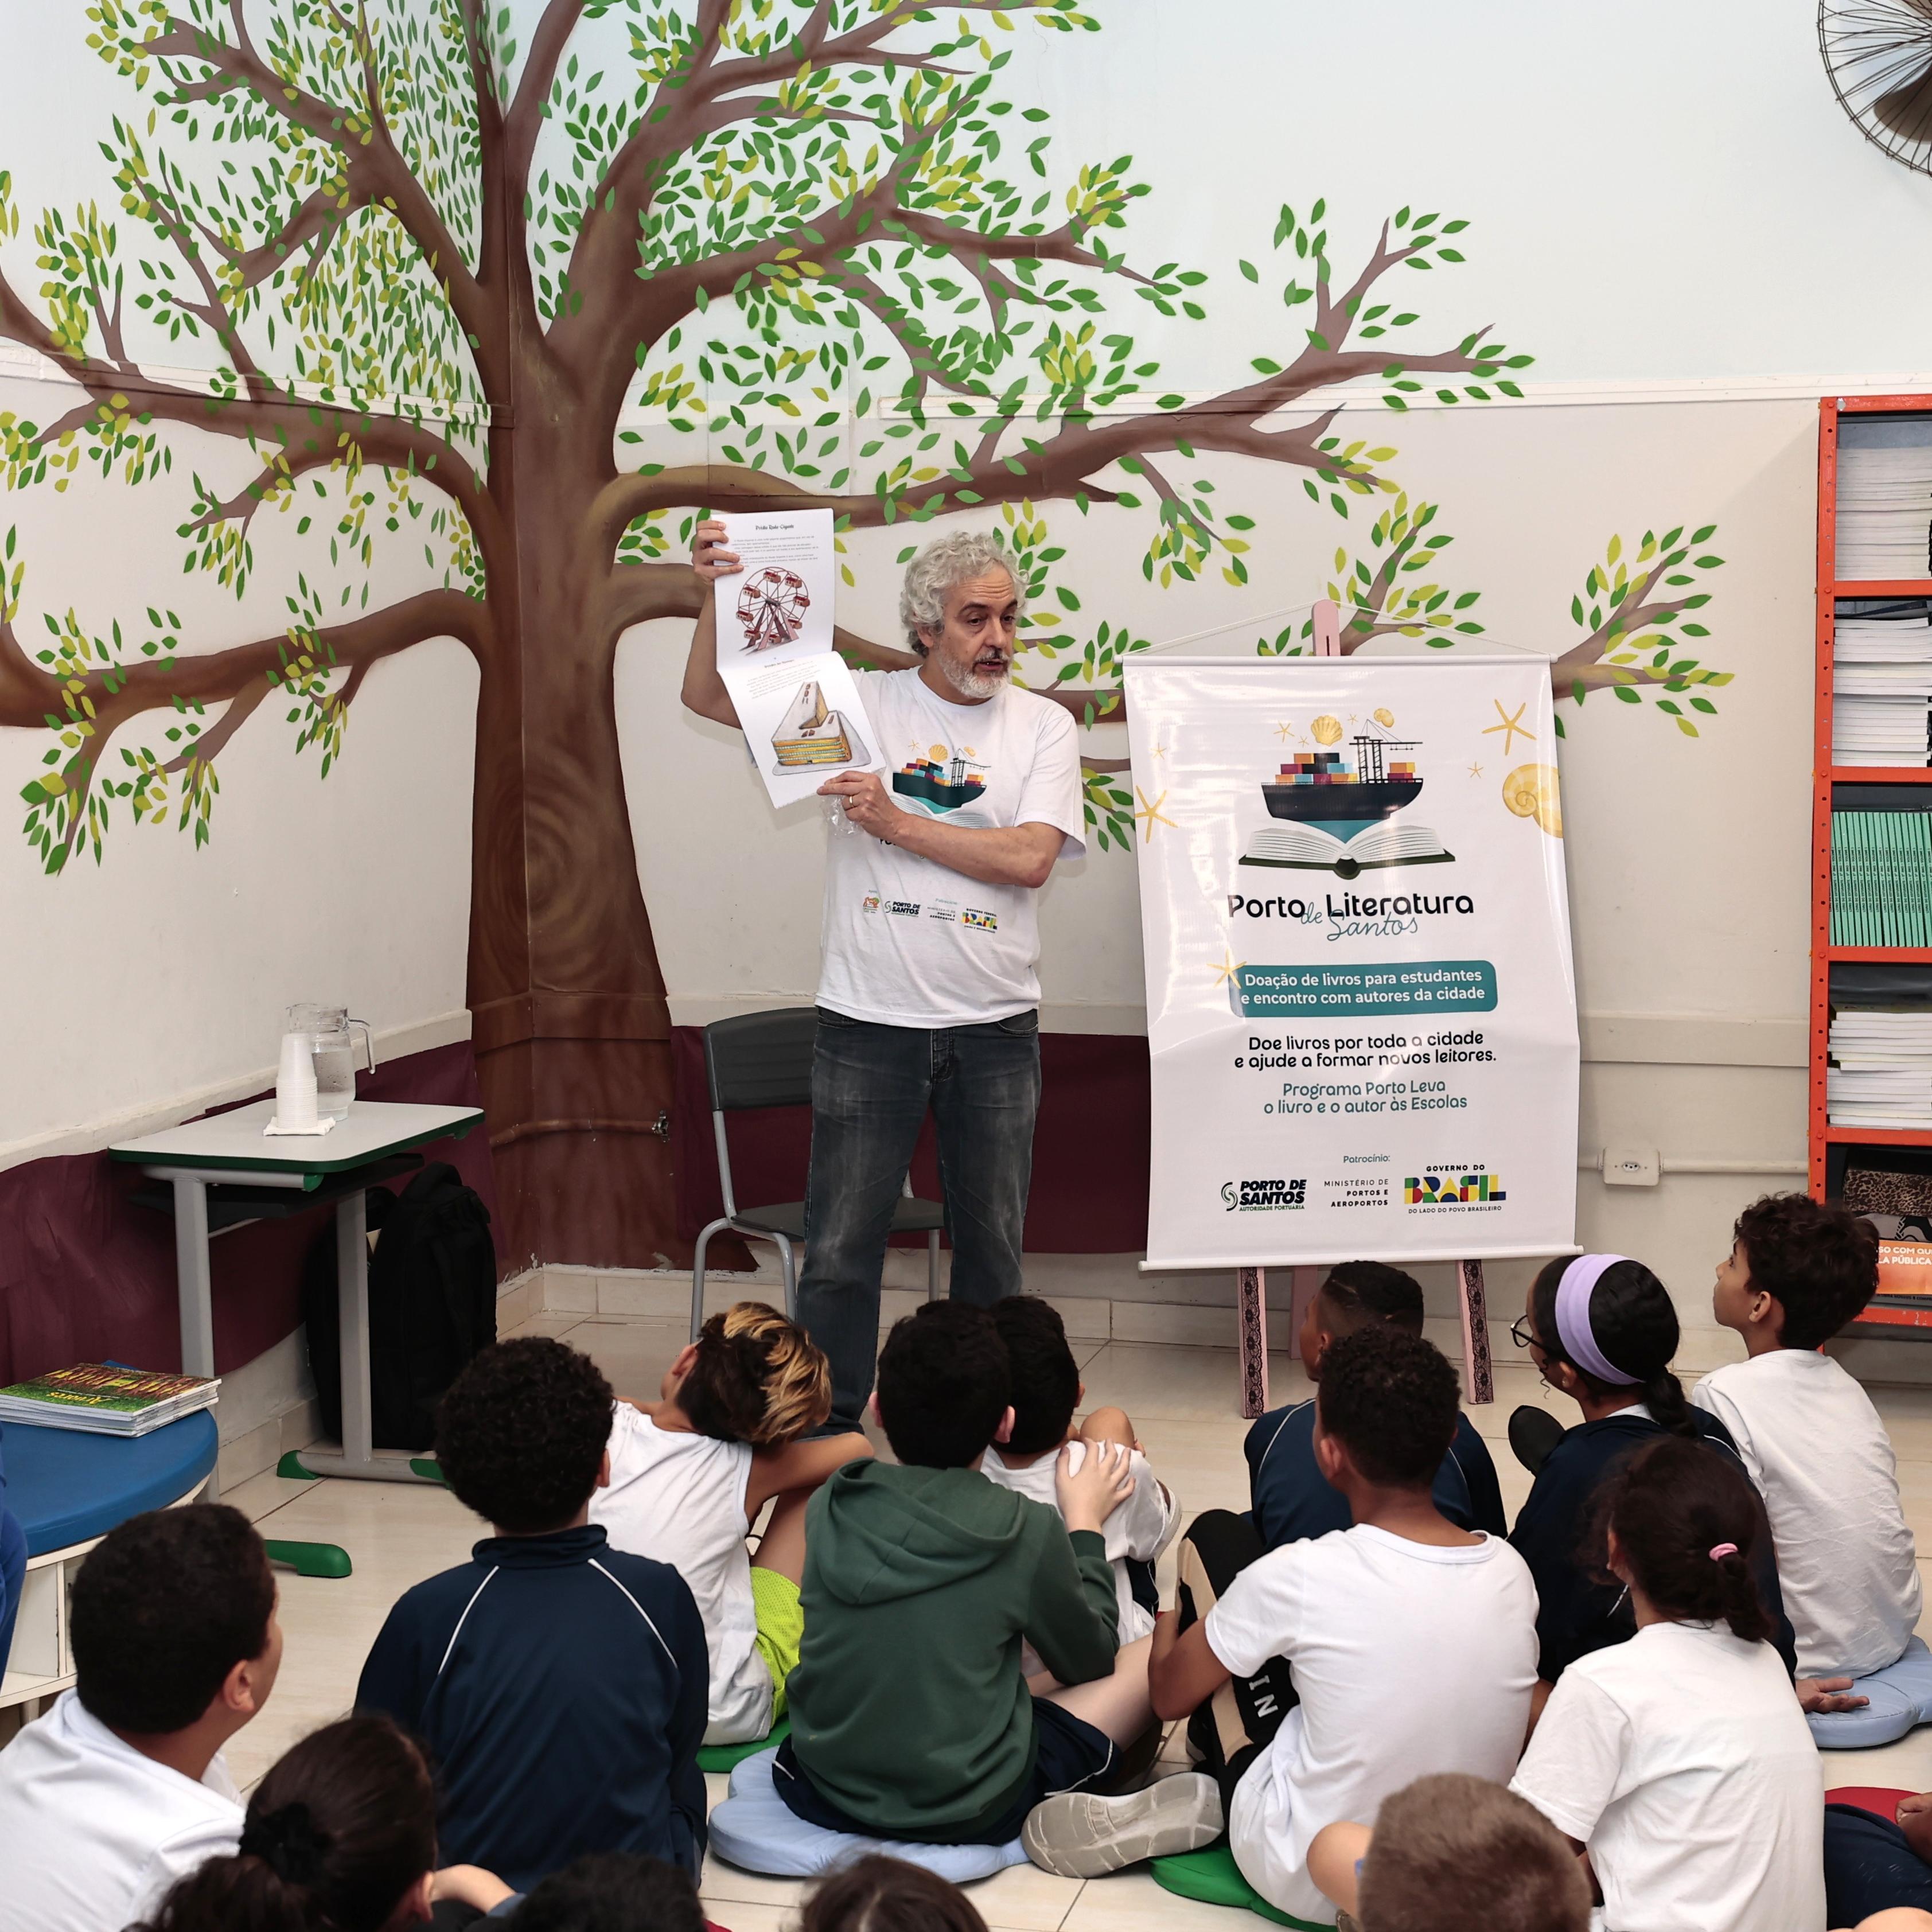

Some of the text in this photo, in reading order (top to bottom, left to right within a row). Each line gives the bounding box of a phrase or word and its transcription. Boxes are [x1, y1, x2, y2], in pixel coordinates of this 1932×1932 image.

[891, 906, 919, 915] SANTOS
[1228, 893, 1474, 925] Porto de Literatura
[961, 912, 998, 930] BRASIL
[1327, 909, 1418, 941] Santos
[1245, 969, 1482, 990] Doação de livros para estudantes
[1241, 987, 1485, 1004] e encontro com autores da cidade
[1249, 1031, 1483, 1053] Doe livros por toda a cidade
[1235, 1049, 1496, 1071] e ajude a formar novos leitores.
[1284, 1081, 1445, 1100] Programa Porto Leva
[1264, 1094, 1467, 1113] o livro e o autor às Escolas
[1343, 1154, 1390, 1163] Patrocínio:
[1240, 1179, 1307, 1191] PORTO DE
[1405, 1175, 1506, 1203] BRASIL
[1240, 1191, 1304, 1205] SANTOS
[1892, 1254, 1932, 1265] PÚBLICA
